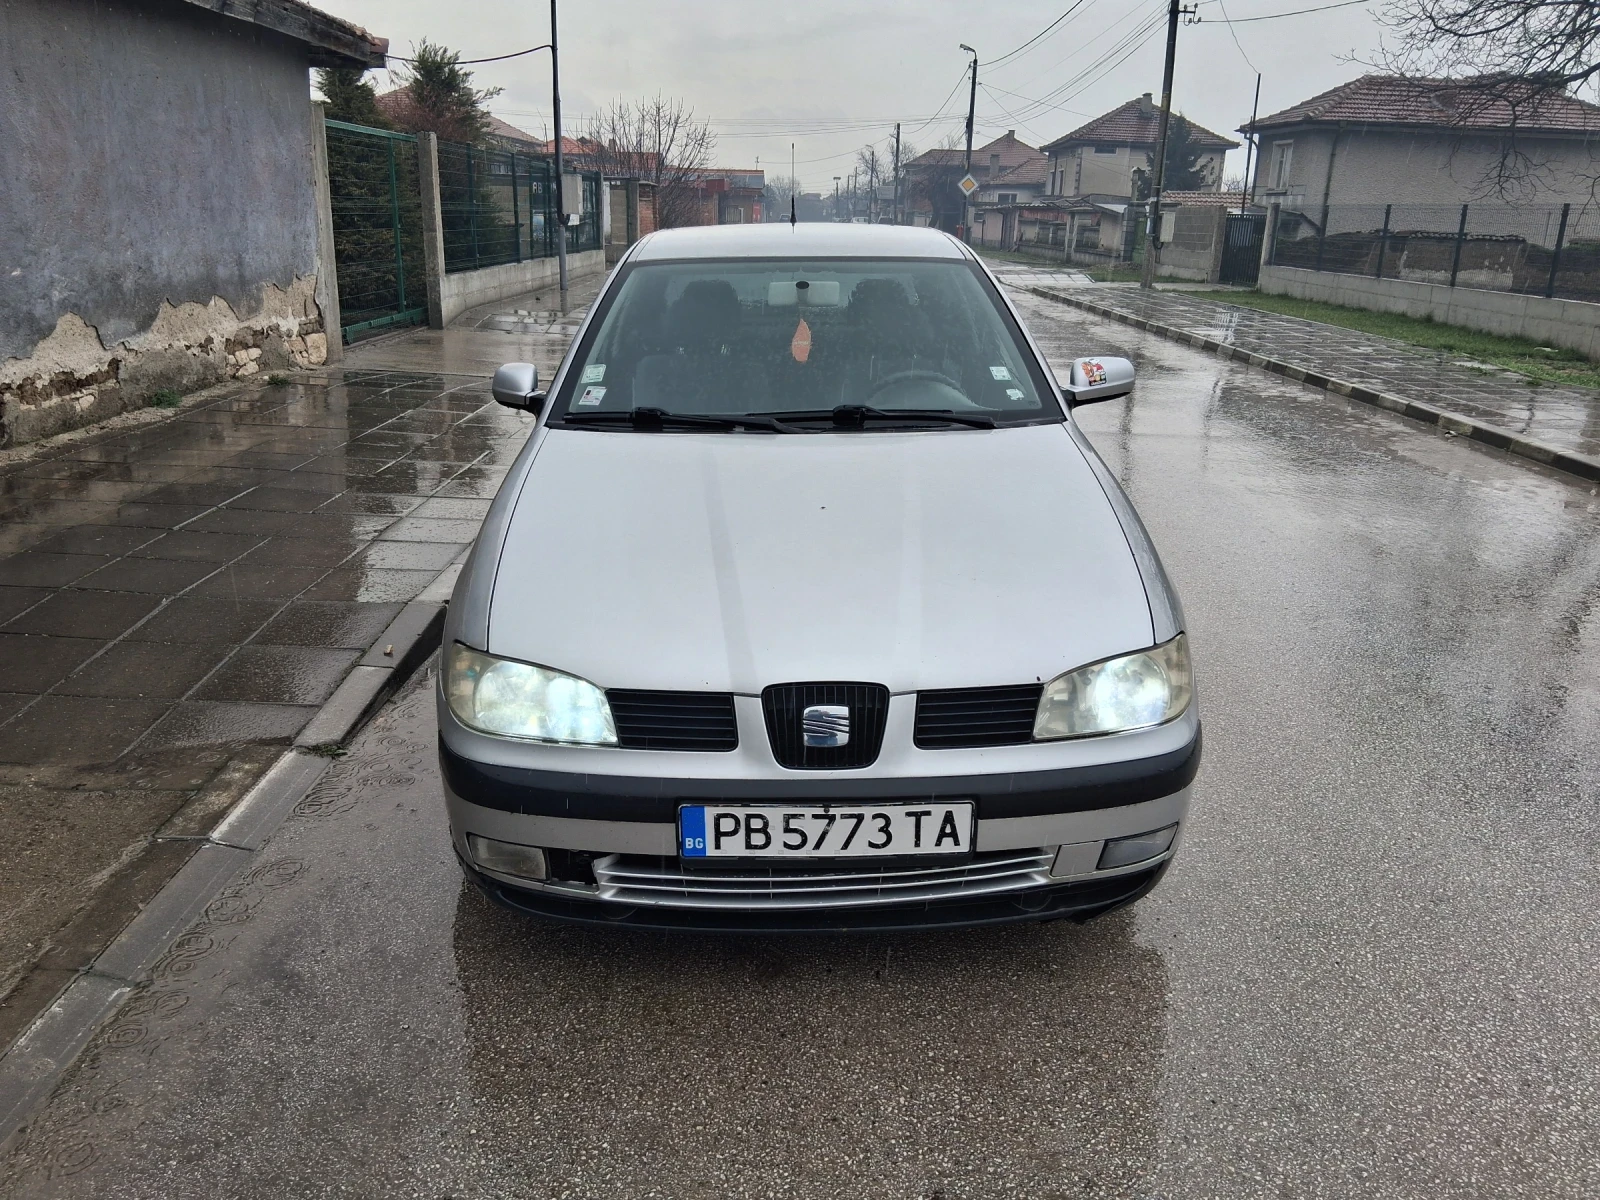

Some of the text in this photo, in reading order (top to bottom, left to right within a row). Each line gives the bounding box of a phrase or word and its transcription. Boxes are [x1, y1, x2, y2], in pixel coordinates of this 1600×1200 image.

[685, 837, 704, 849] BG
[713, 810, 961, 850] PB 5773 TA
